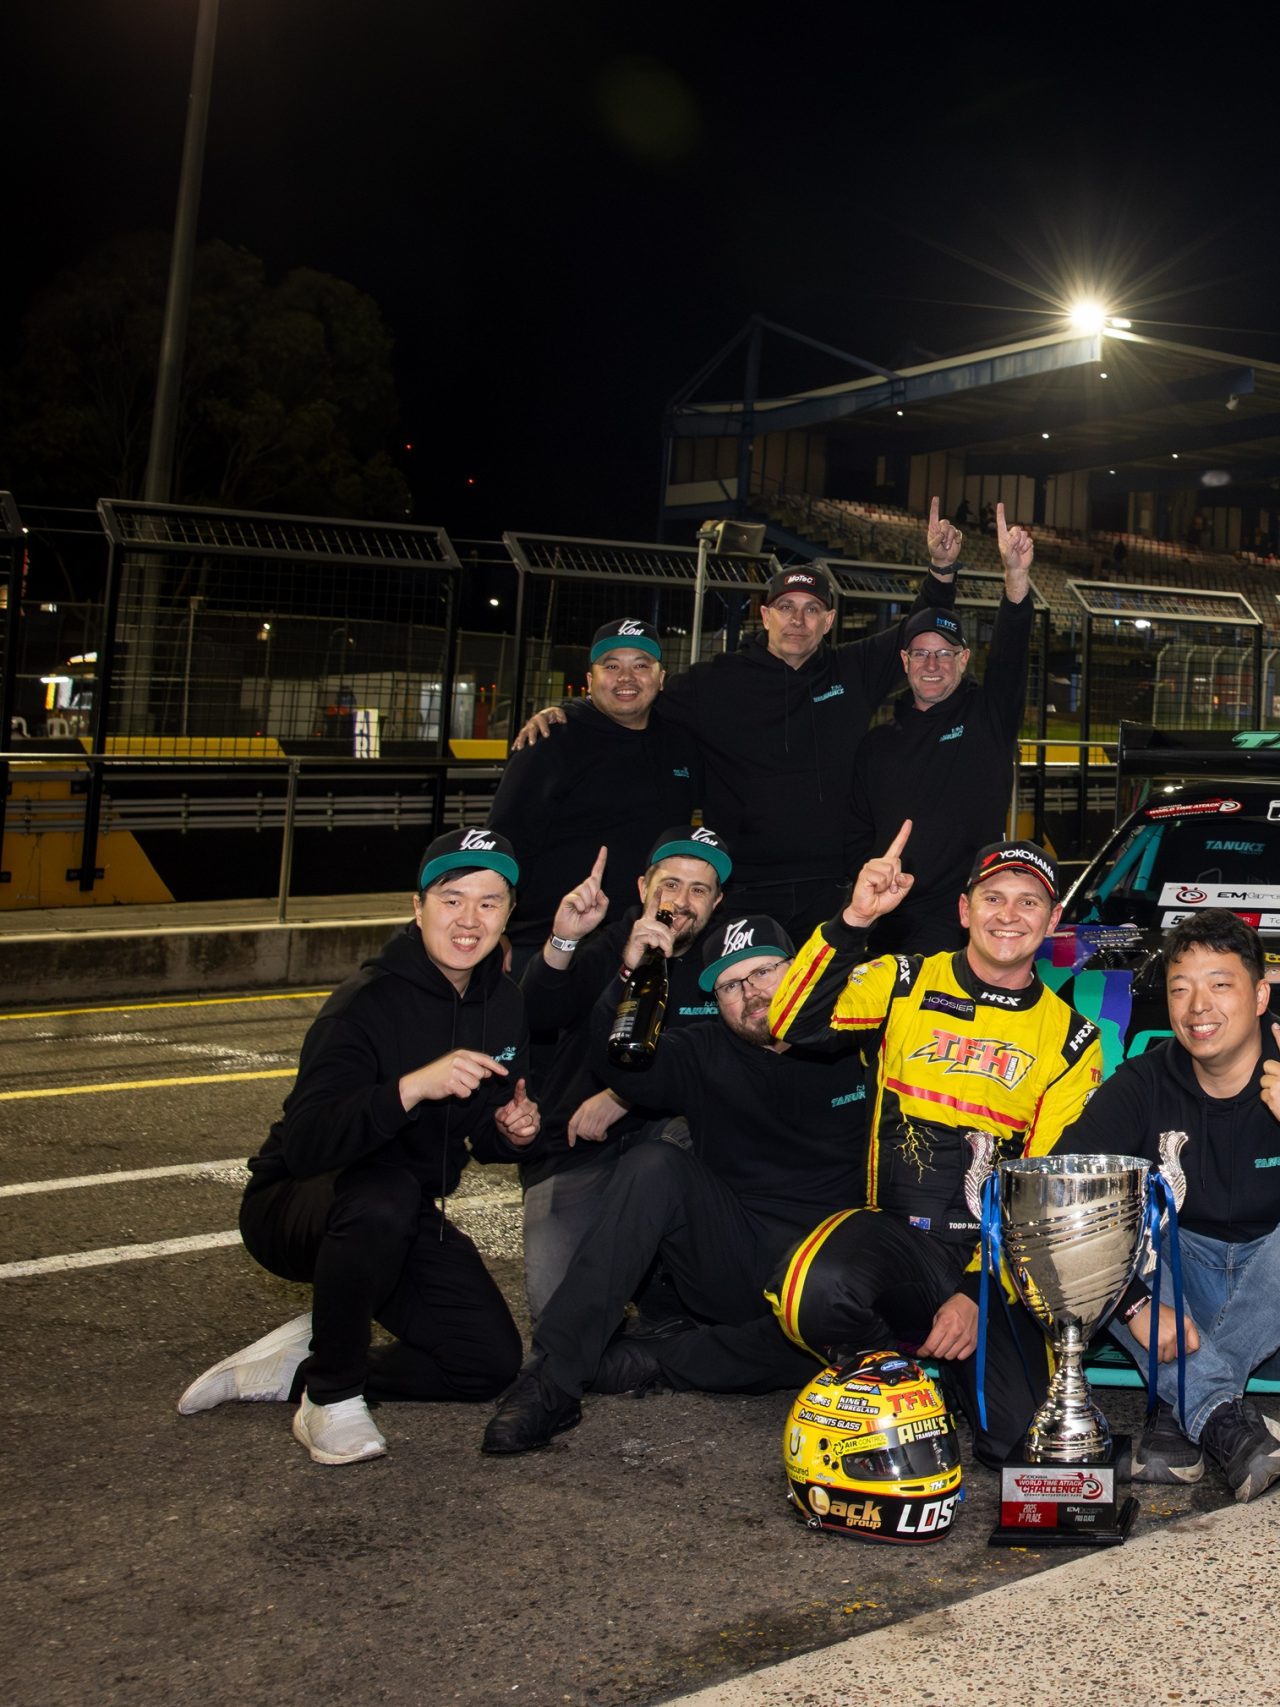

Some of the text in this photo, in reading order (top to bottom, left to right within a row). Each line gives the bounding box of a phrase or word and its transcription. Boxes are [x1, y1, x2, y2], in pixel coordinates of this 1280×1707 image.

[1205, 840, 1265, 852] TANUKI
[1000, 849, 1054, 881] YOKOHAMA
[923, 996, 974, 1013] HOOSIER
[980, 991, 1023, 1006] HRX
[1069, 1021, 1095, 1051] HRX
[932, 1029, 1013, 1078] TFH
[885, 1390, 933, 1413] TFH
[814, 1414, 836, 1426] POINTS
[837, 1421, 861, 1431] GLASS
[897, 1416, 949, 1445] AUHL'S
[845, 1440, 857, 1448] AIR
[858, 1434, 887, 1445] CONTROL
[915, 1430, 941, 1440] TRANSPORT
[1021, 1486, 1083, 1494] CHALLENGE
[846, 1517, 883, 1530] group
[1026, 1513, 1042, 1523] PLACE
